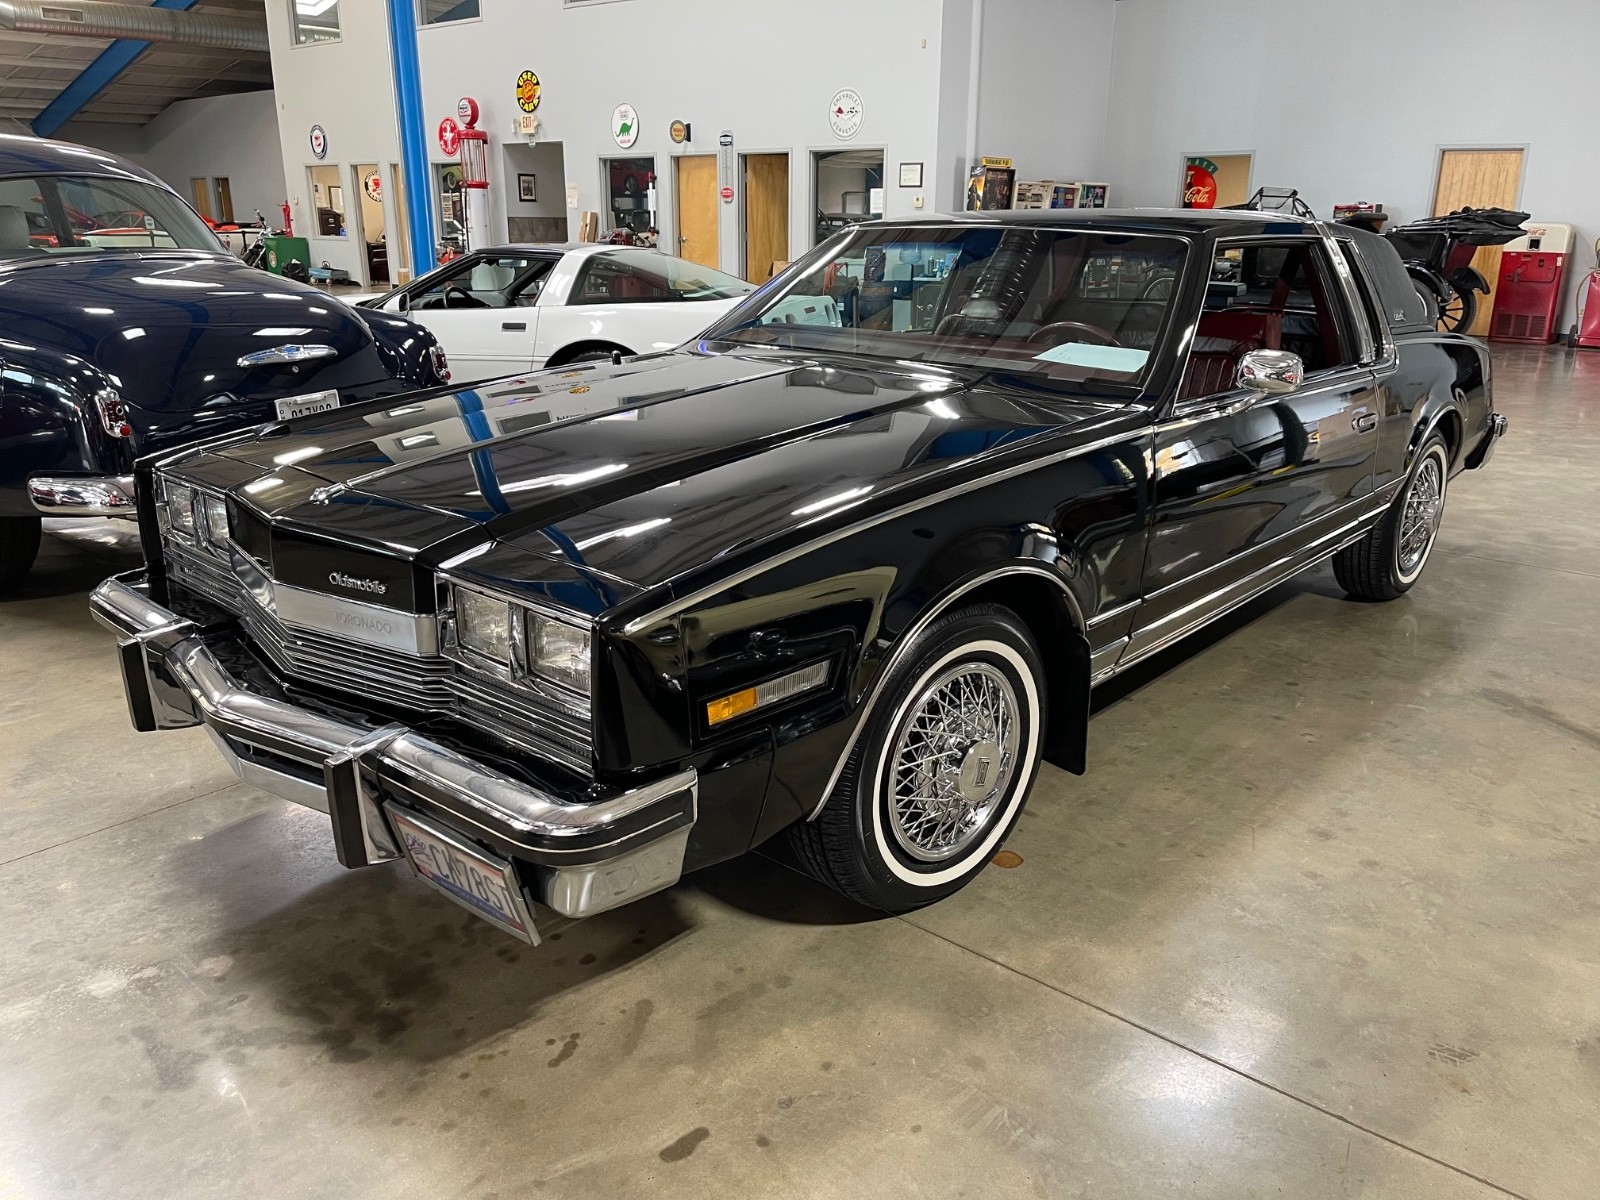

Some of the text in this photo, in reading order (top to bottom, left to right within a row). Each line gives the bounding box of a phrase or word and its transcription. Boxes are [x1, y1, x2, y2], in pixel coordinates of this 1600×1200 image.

[518, 72, 538, 86] USED
[519, 98, 539, 112] CARS
[833, 92, 860, 106] CHEVROLET
[522, 116, 532, 129] EXIT
[1184, 186, 1211, 203] Cola
[329, 571, 387, 594] Oldsmobile
